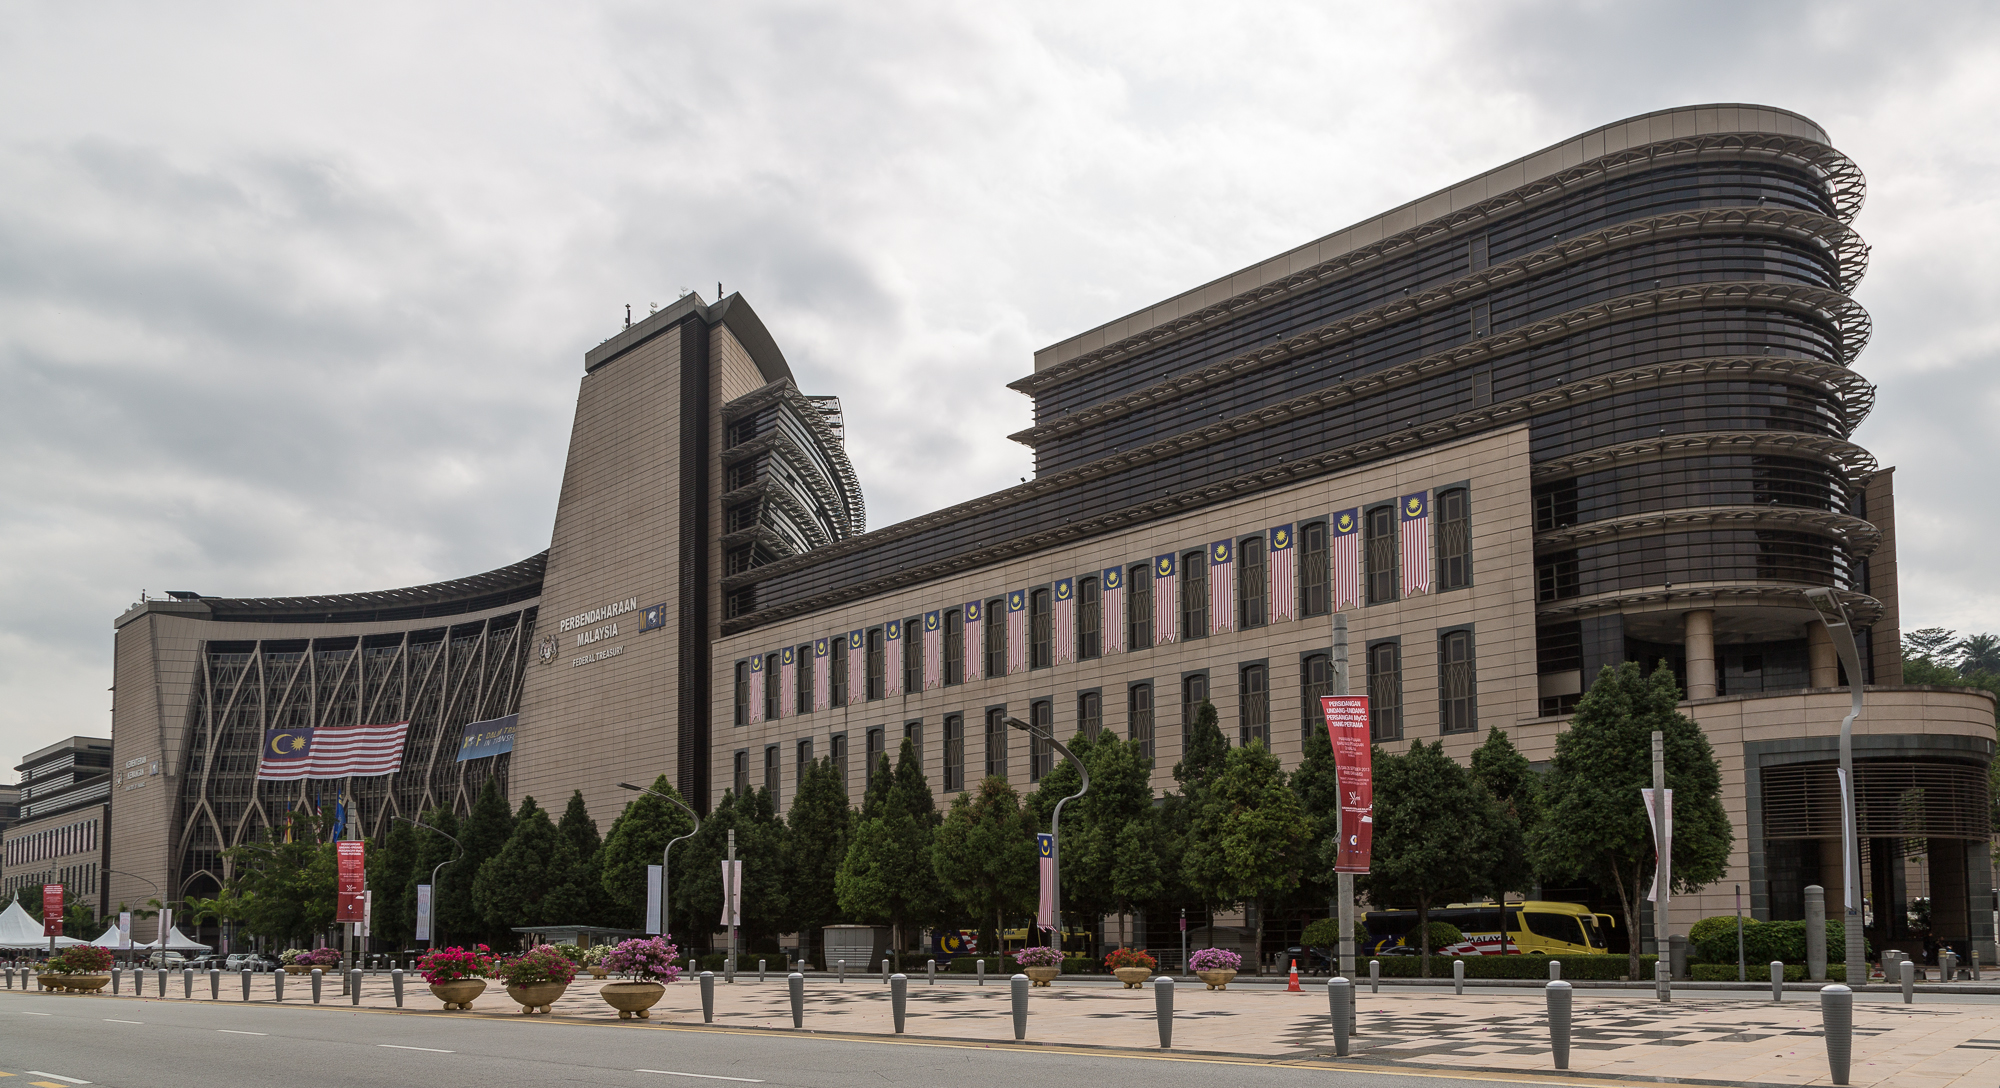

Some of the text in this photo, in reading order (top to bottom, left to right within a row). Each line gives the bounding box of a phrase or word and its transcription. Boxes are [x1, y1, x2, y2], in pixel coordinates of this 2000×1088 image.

[560, 597, 637, 632] PERBENDAHARAAN
[577, 623, 618, 646] MALAYSIA
[573, 645, 624, 667] FEDERAL TREASURY
[1467, 935, 1516, 943] MALAYIA
